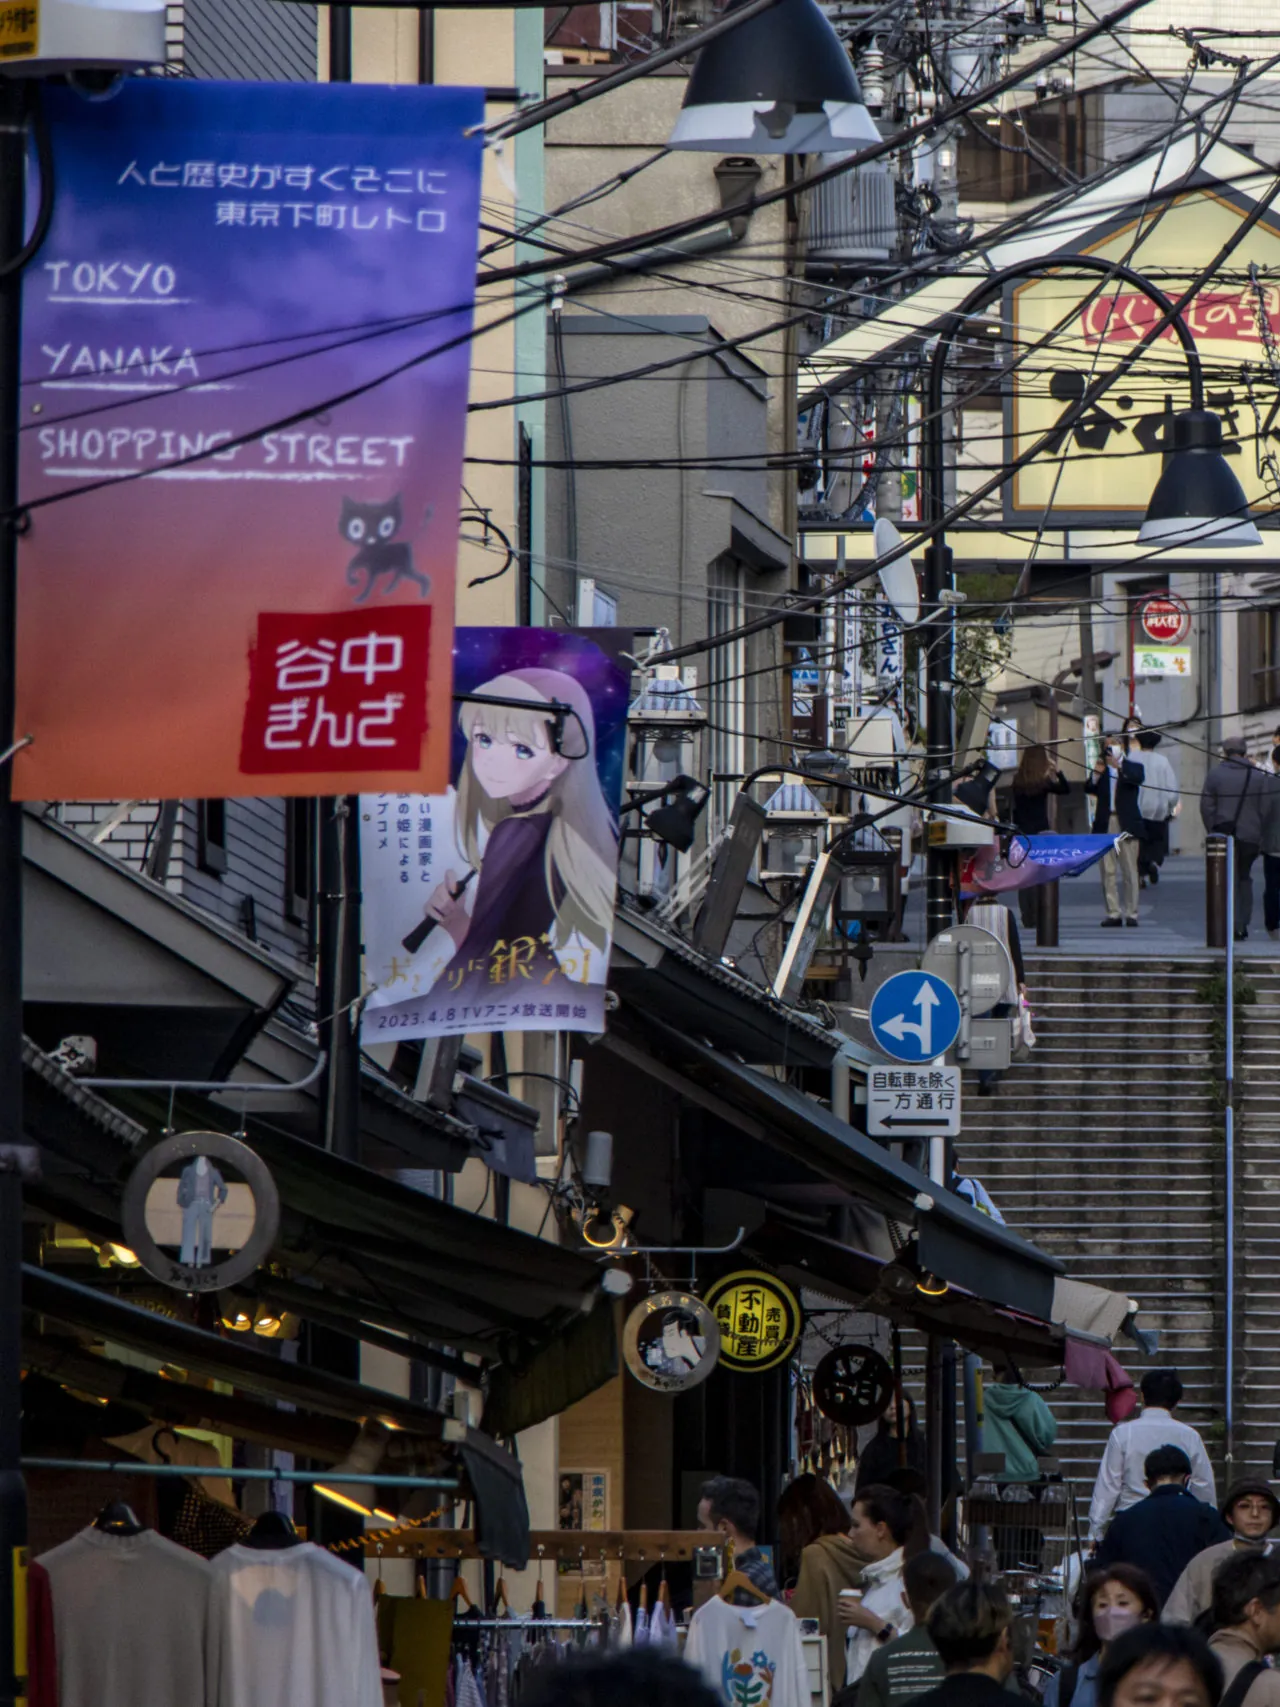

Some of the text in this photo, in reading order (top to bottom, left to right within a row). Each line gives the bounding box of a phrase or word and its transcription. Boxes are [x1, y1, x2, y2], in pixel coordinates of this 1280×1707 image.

[215, 202, 446, 233] 東京下町レトロ
[45, 262, 176, 294] TOKYO
[41, 344, 200, 377] YANAKA
[38, 428, 415, 467] SHOPPING STREET
[276, 631, 403, 690] 谷中
[264, 692, 405, 750] ぎんざ
[377, 793, 389, 850] ブコメ
[418, 793, 432, 883] い漫画家と
[378, 1007, 456, 1029] 2023.4.8
[461, 1003, 588, 1020] TVアニメ放送開始
[873, 1071, 955, 1089] 自転車を除く
[873, 1092, 955, 1110] 一方通行
[735, 1288, 761, 1358] 不動産
[765, 1307, 781, 1338] 売買
